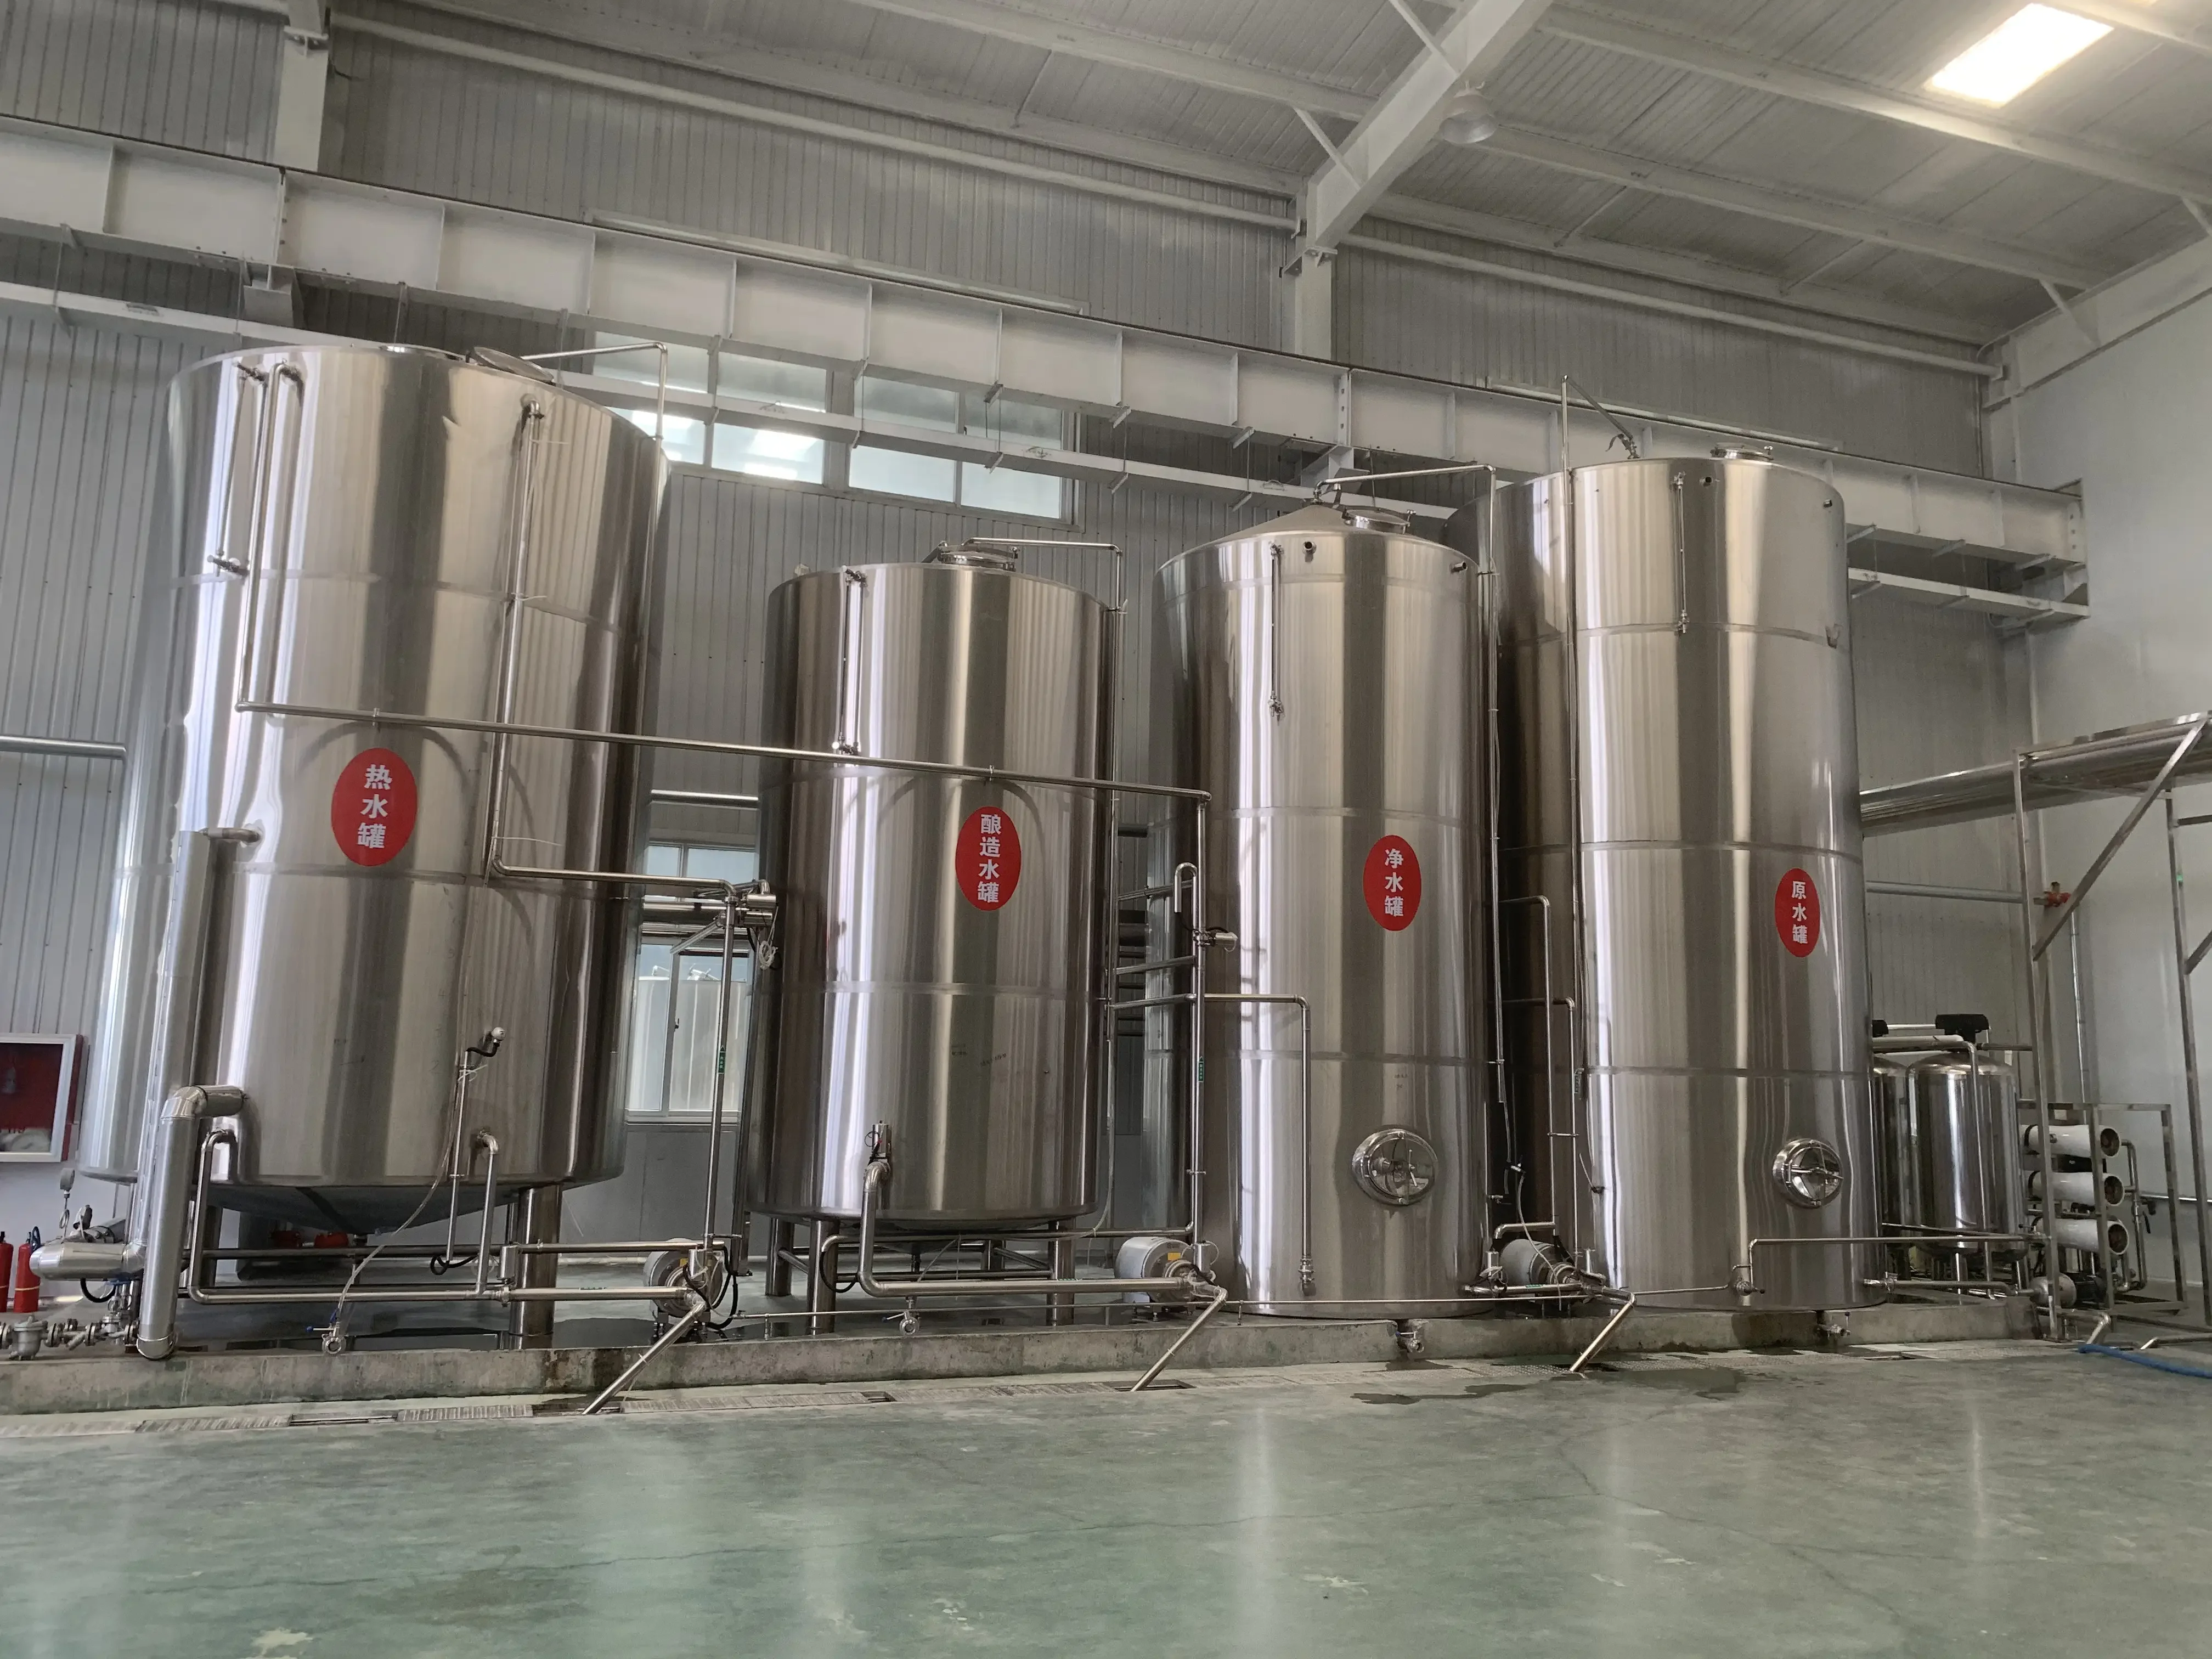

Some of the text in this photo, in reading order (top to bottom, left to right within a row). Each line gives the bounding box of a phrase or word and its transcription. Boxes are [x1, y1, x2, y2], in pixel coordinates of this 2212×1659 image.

[358, 764, 392, 849] 热水罐
[978, 814, 1001, 903] 酿造水罐
[1385, 848, 1404, 917] 净水罐
[1791, 881, 1808, 944] 原水罐
